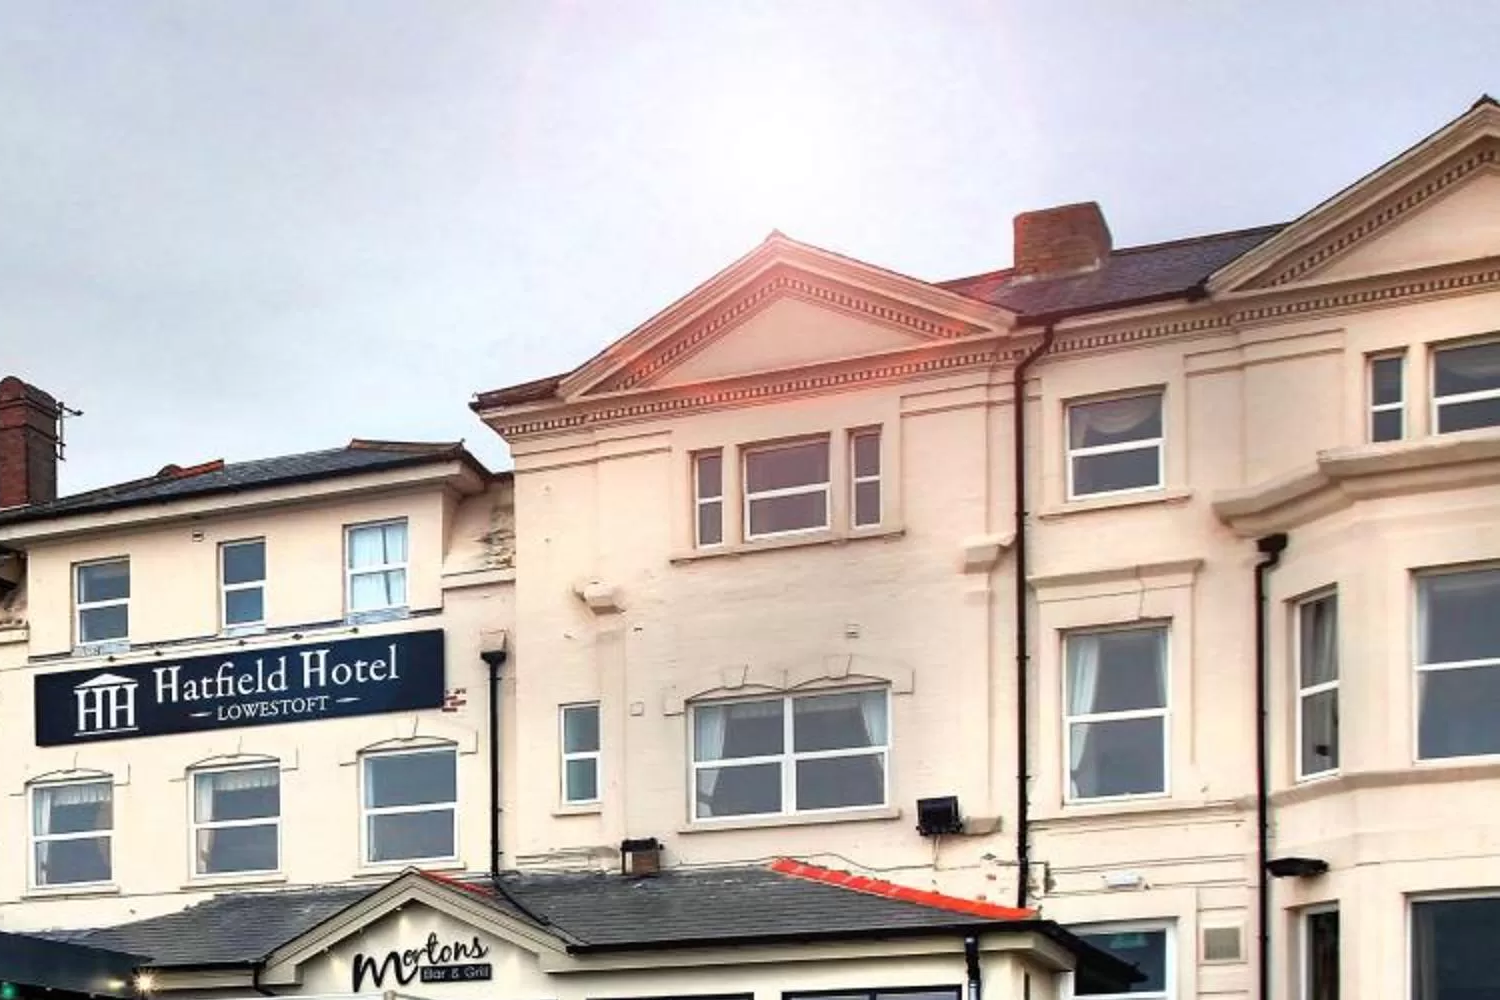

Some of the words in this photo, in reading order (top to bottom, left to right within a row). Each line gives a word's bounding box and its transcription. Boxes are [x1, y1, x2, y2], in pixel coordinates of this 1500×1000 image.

[152, 656, 288, 704] Hatfield
[300, 644, 400, 689] Hotel
[217, 695, 329, 721] LOWESTOFT
[352, 932, 490, 993] Mortons
[423, 967, 446, 980] Bar
[463, 966, 489, 979] Grill
